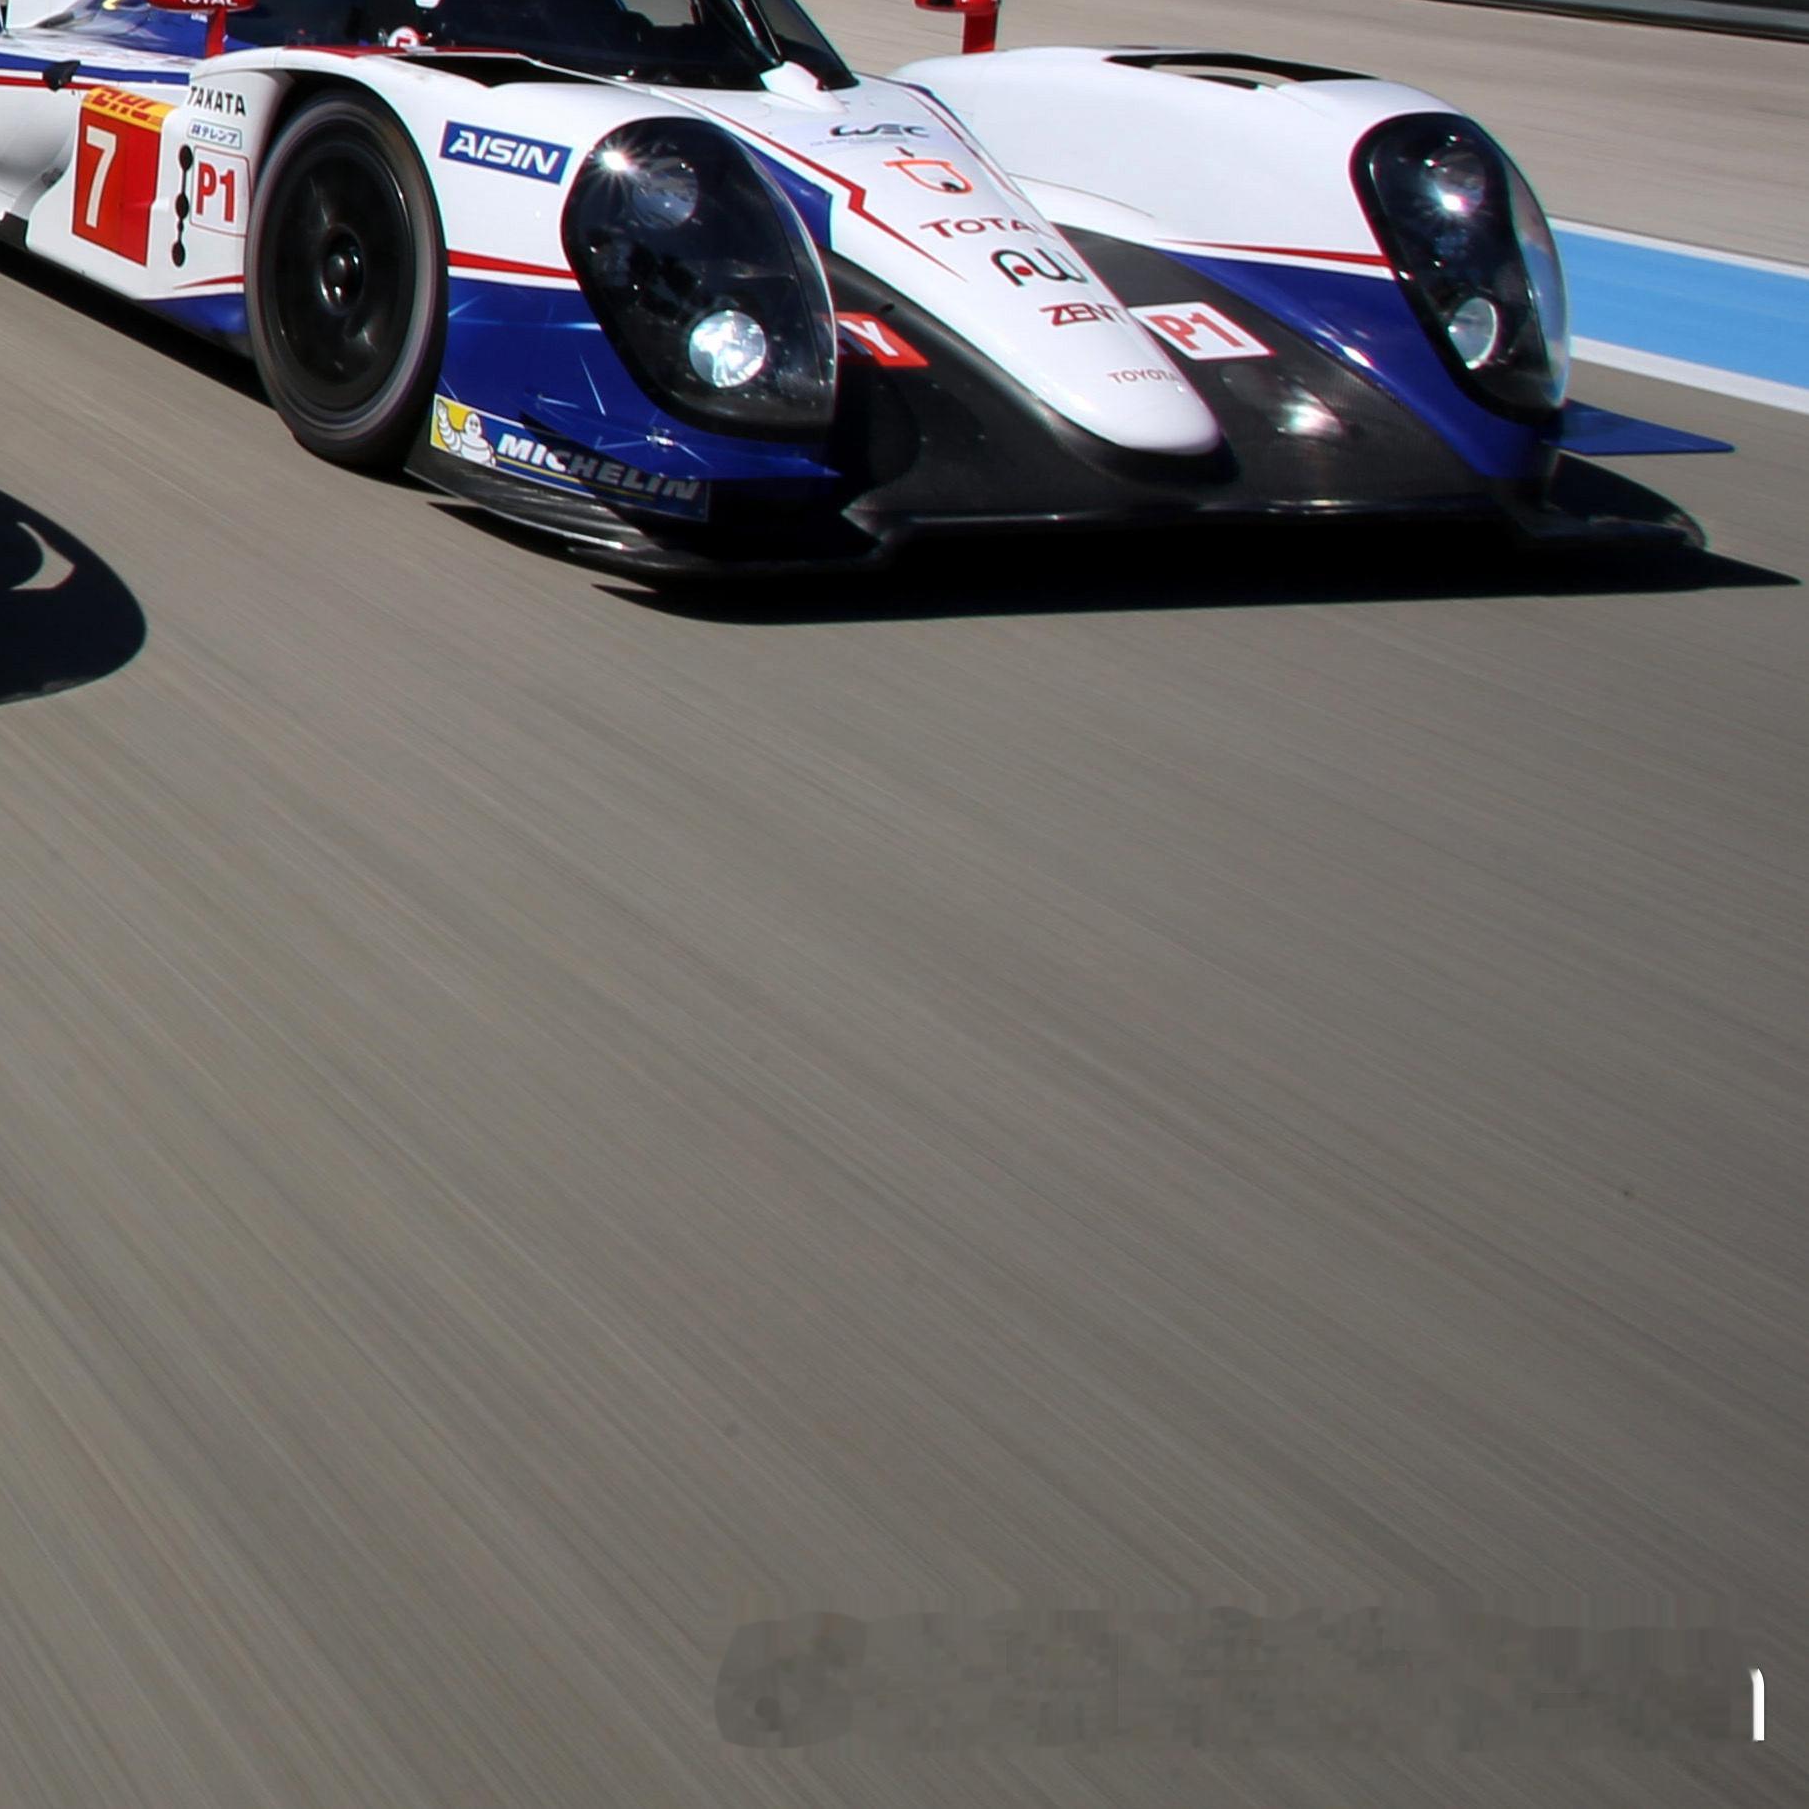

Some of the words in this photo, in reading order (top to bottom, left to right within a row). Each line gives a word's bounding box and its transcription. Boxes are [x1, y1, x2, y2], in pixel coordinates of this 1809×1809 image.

[188, 86, 246, 117] TAKATA
[447, 129, 560, 175] AISIN
[87, 124, 116, 228] 7
[196, 160, 236, 223] P1
[1039, 304, 1128, 326] ZENT
[1150, 312, 1246, 351] P1
[497, 433, 701, 501] MICHELIN
